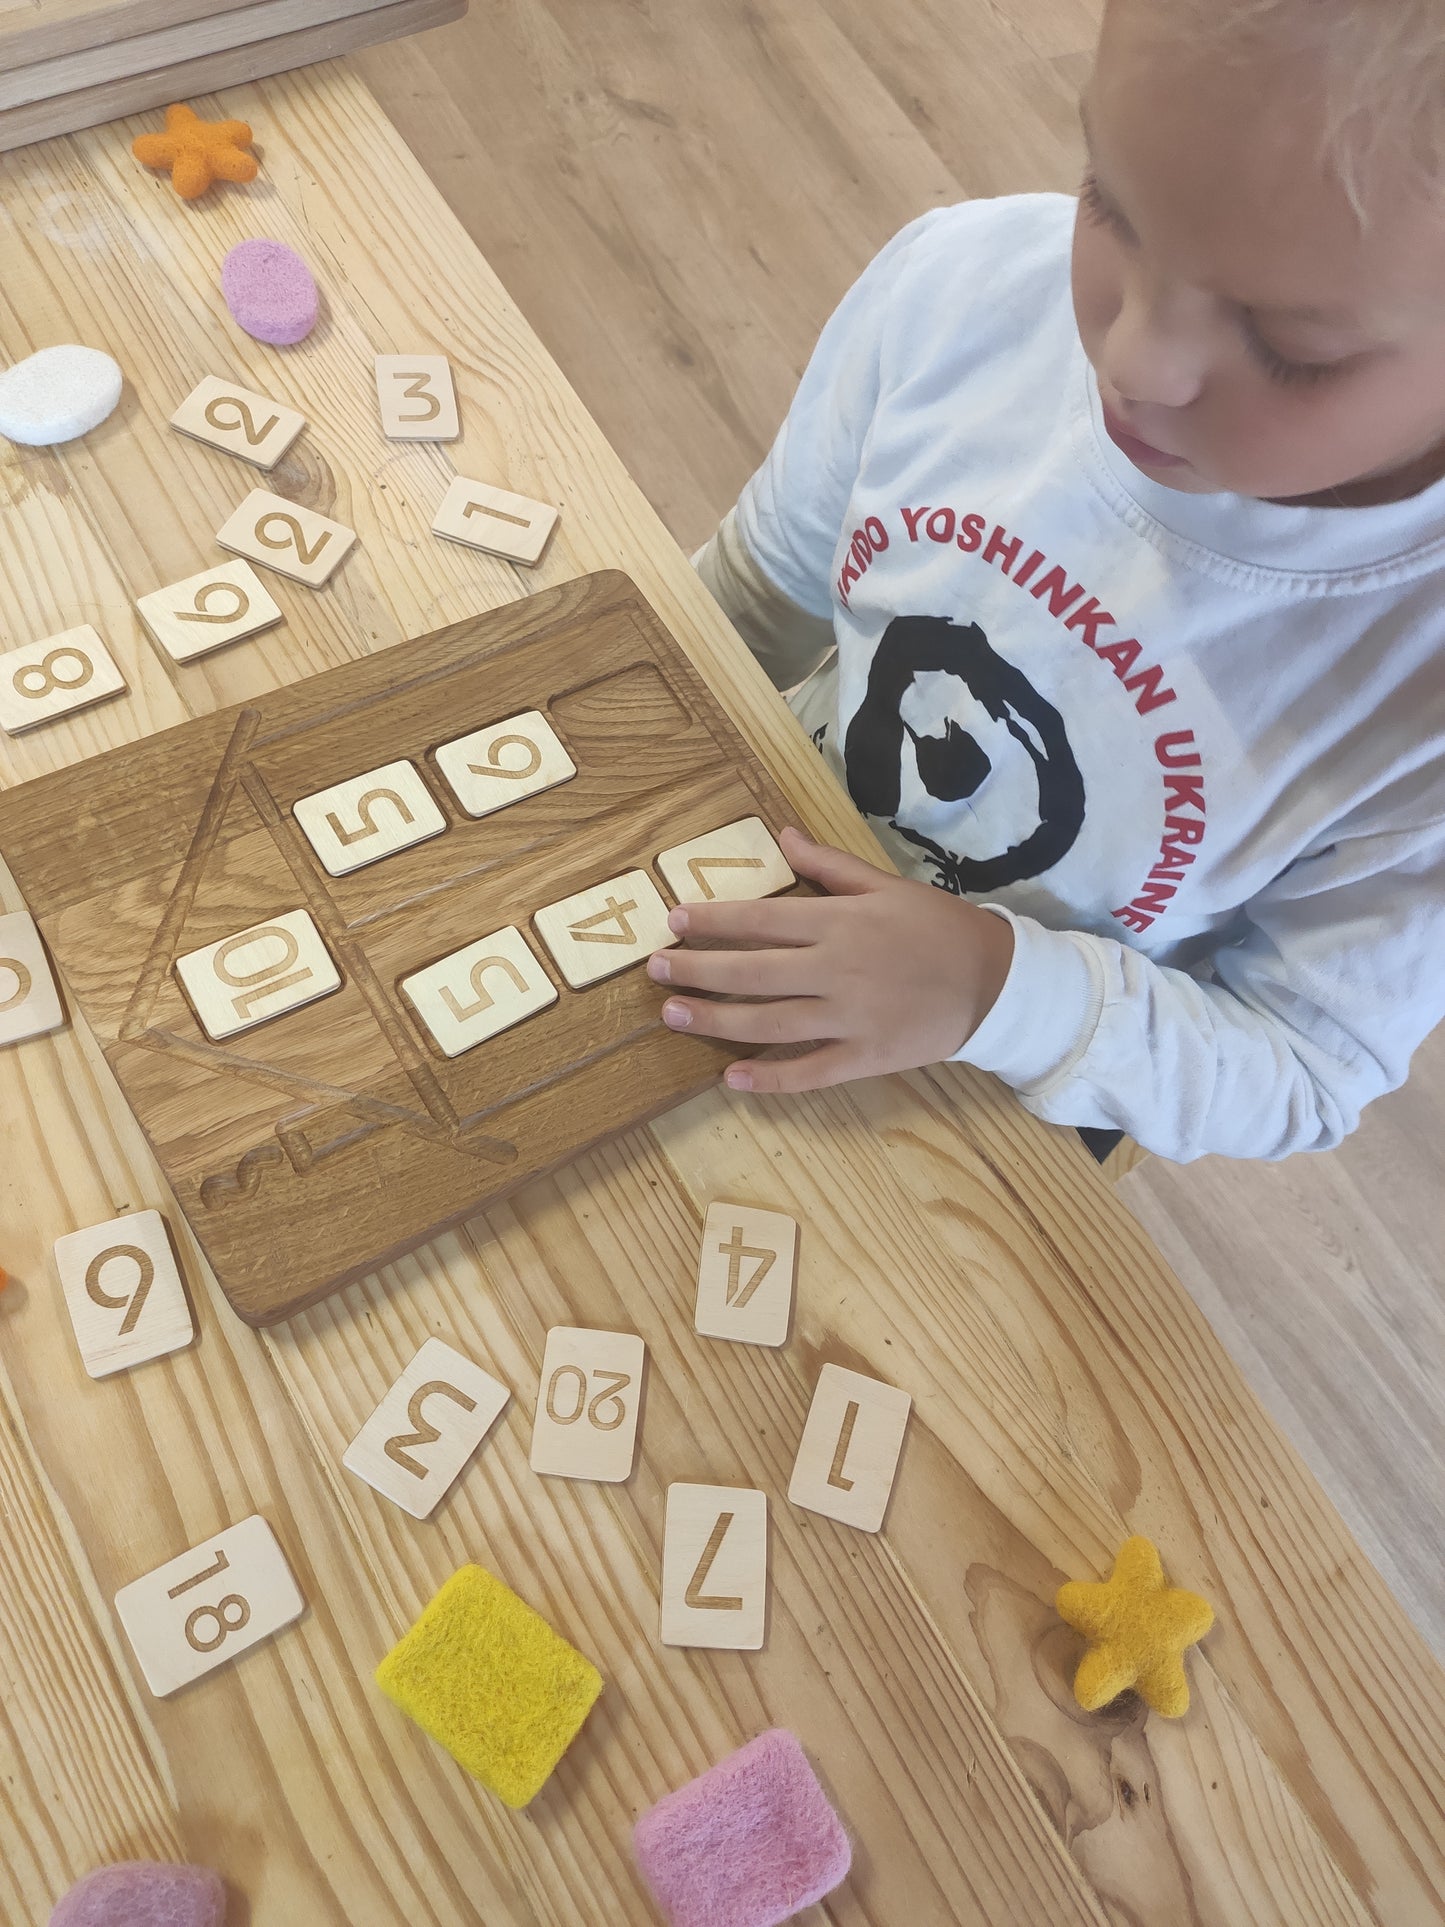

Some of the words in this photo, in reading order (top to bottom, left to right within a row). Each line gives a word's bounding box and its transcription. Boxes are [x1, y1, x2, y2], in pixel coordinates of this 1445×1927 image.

[204, 396, 280, 447] 2
[393, 373, 440, 422] 3
[255, 511, 333, 565] 2
[463, 501, 531, 528] 1
[13, 648, 93, 700] 8
[838, 516, 889, 608] IKIDO
[900, 507, 1177, 716] YOSHINKAN
[1112, 729, 1206, 935] UKRAINE
[326, 787, 415, 847] 5
[687, 857, 763, 900] 7
[569, 896, 638, 945] 4
[212, 925, 313, 1020] 10
[438, 955, 530, 1024] 5
[719, 1226, 777, 1308] 4
[384, 1380, 478, 1481] 3
[546, 1365, 631, 1431] 20
[827, 1401, 859, 1491] 1
[685, 1513, 743, 1610] 7
[168, 1550, 250, 1654] 18
